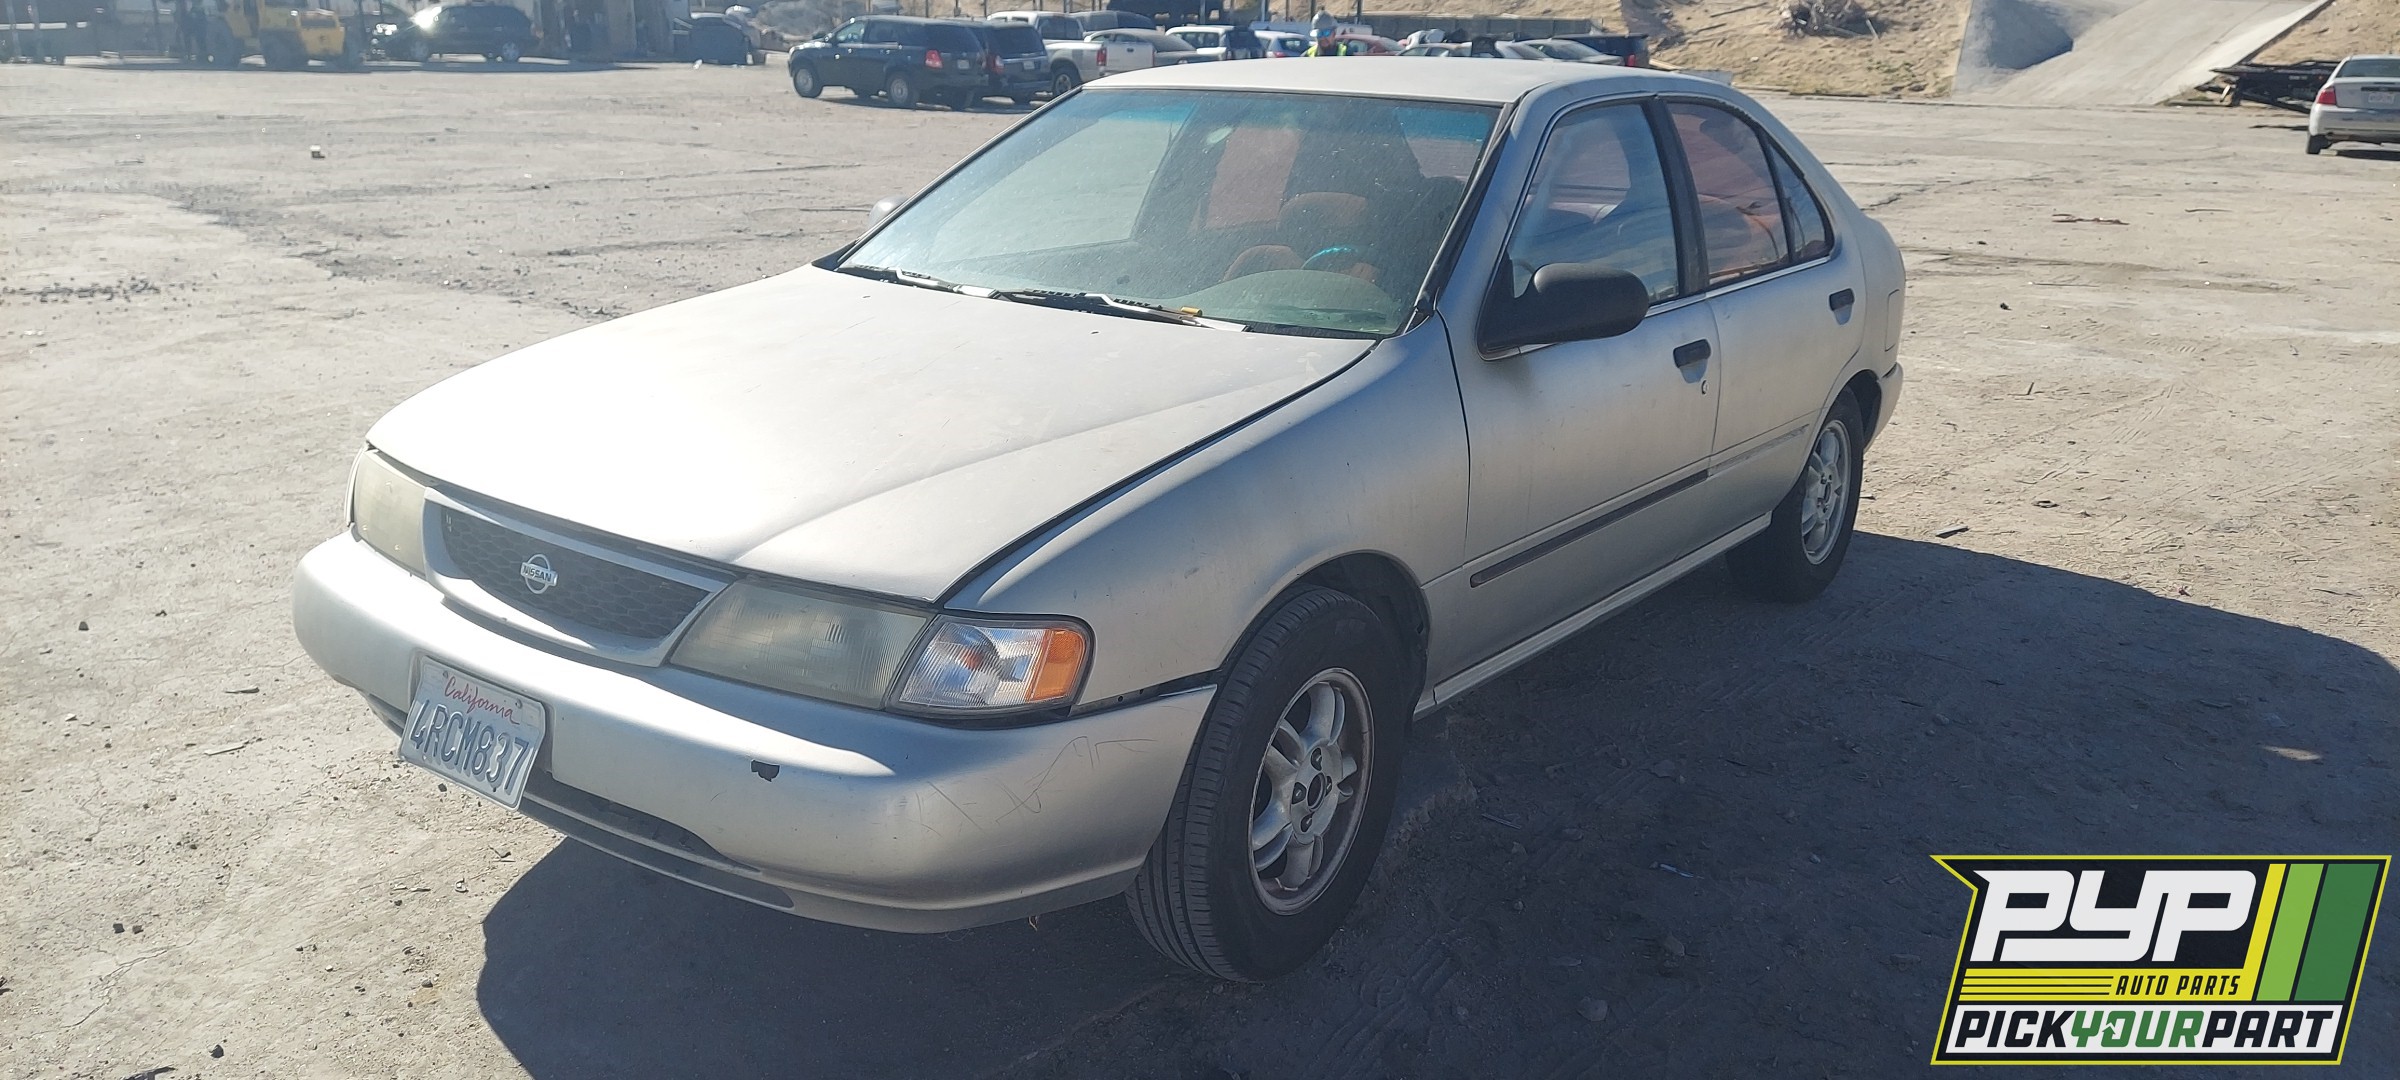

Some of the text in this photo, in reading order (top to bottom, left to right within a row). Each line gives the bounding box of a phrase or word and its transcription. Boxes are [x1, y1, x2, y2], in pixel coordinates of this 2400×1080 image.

[522, 564, 553, 582] NISSAN
[444, 676, 520, 725] California
[410, 700, 530, 790] 4RCM837
